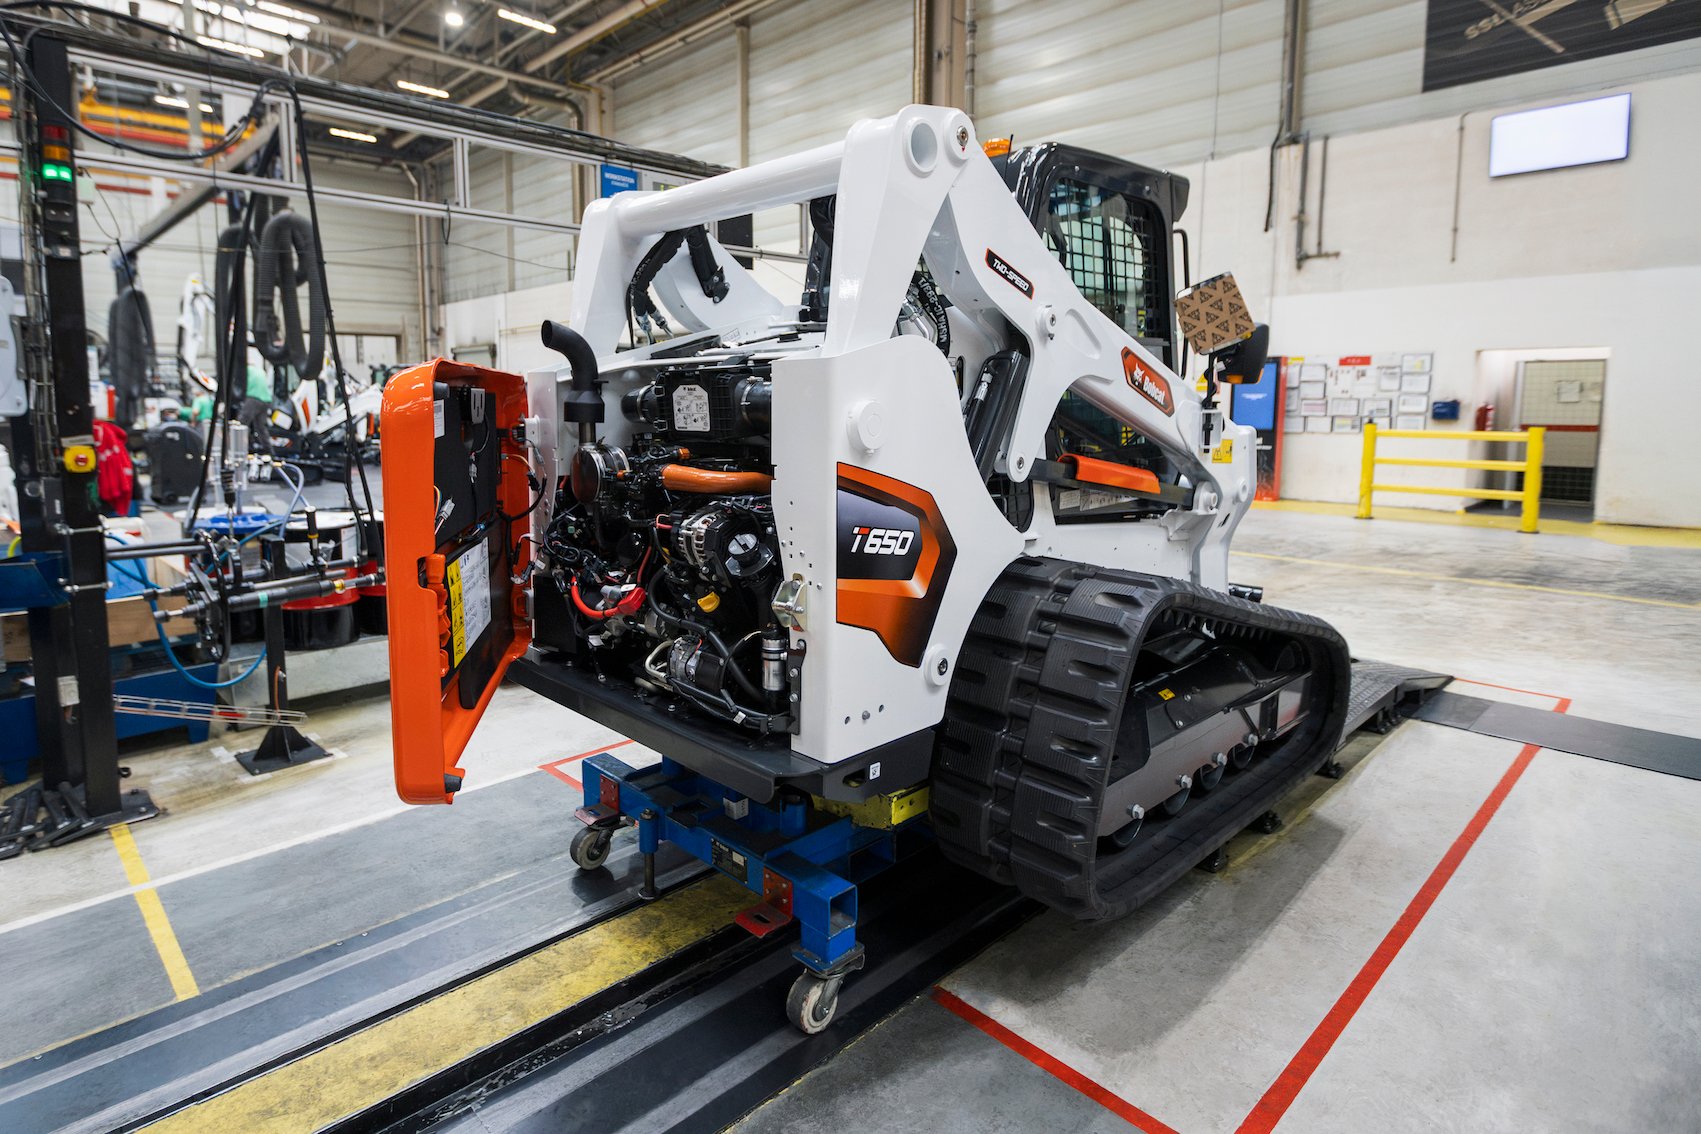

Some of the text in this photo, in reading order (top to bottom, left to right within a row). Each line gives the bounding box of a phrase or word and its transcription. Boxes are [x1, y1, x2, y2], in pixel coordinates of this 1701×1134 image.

[992, 258, 1030, 292] TWO-SPEED
[1143, 375, 1166, 405] Bobcat
[851, 526, 916, 556] T650
